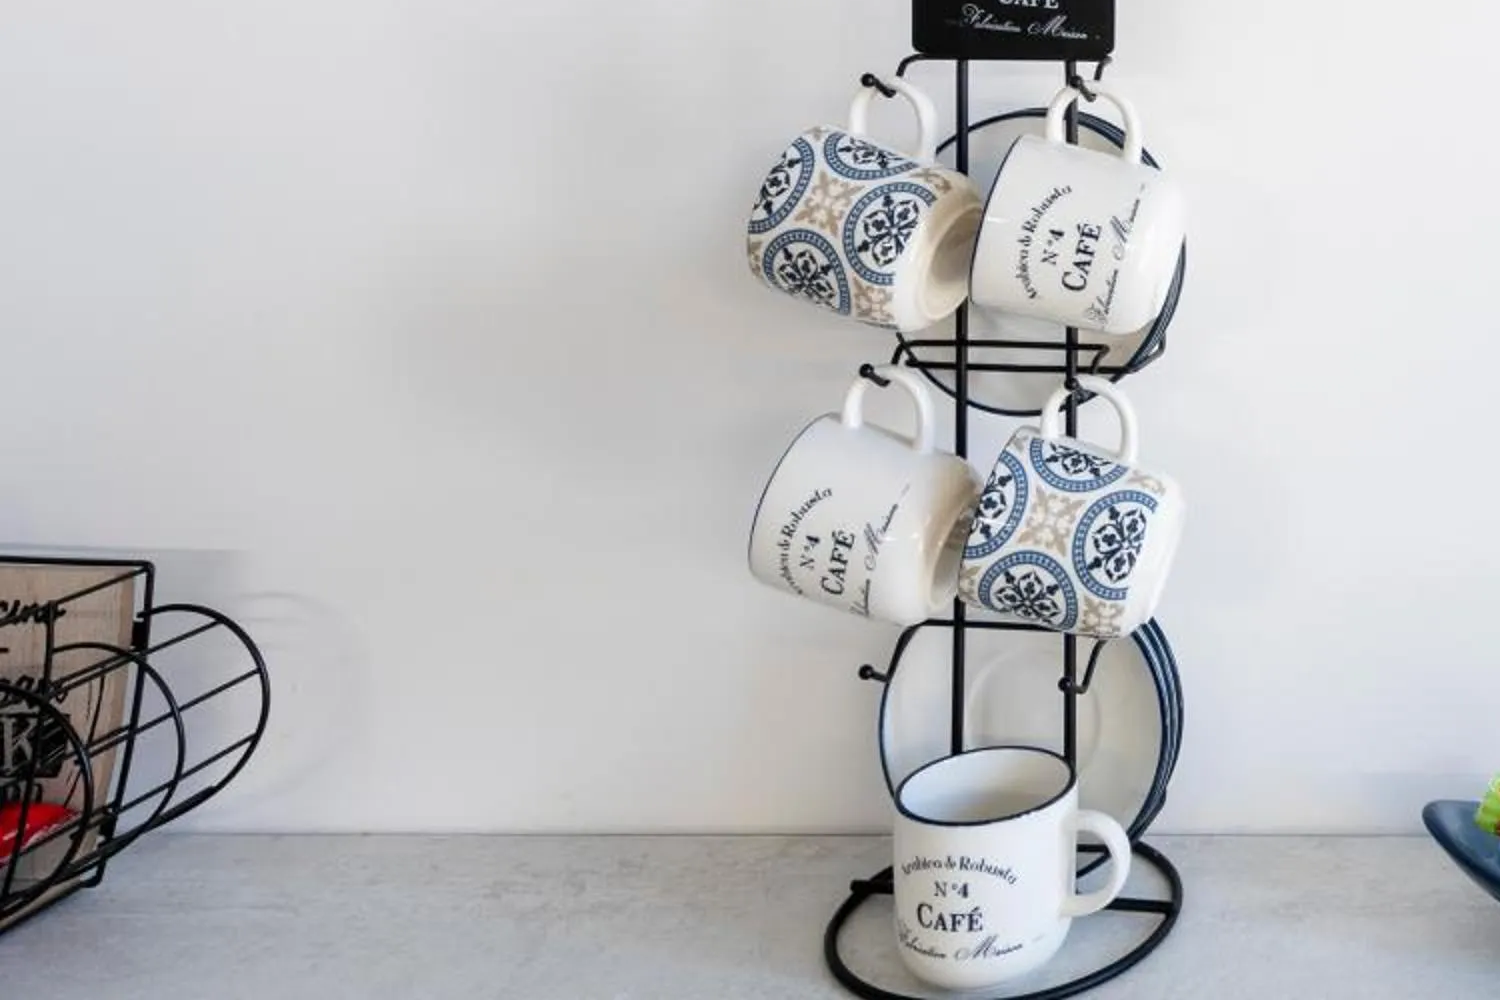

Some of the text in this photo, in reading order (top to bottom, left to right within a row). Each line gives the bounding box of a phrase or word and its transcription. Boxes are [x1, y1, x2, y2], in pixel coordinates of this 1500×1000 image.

[1061, 222, 1102, 292] CAFÉ
[819, 529, 856, 596] CAFÉ
[916, 902, 984, 933] CAFÉ
